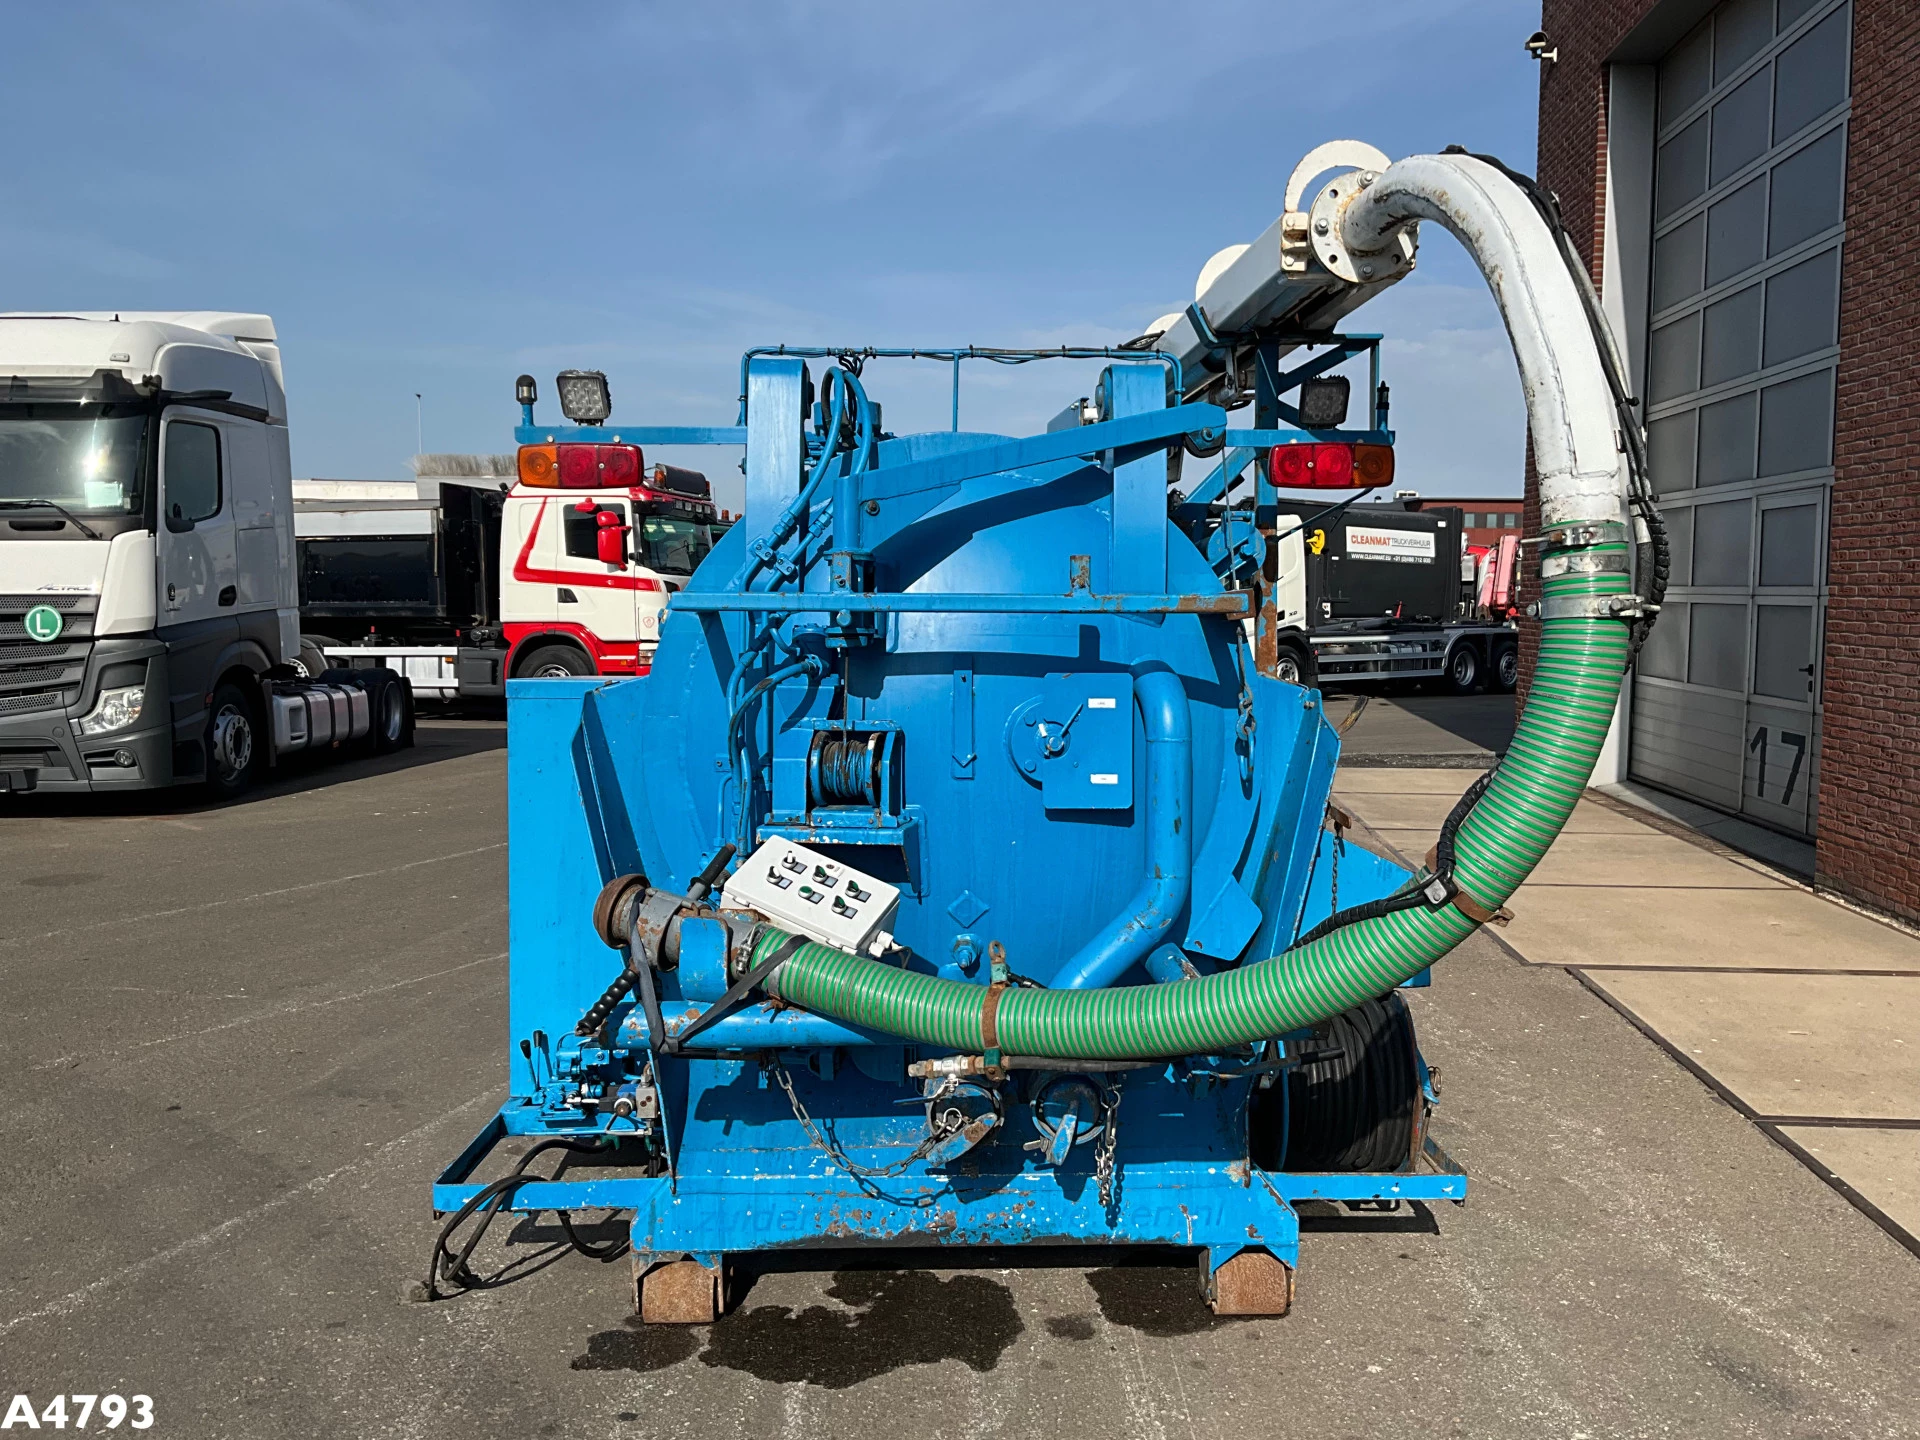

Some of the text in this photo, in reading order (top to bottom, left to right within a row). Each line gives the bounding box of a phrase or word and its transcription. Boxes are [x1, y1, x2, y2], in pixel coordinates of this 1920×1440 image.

[1351, 534, 1391, 546] CLEANMAT
[36, 612, 51, 634] L
[1750, 726, 1806, 806] 17
